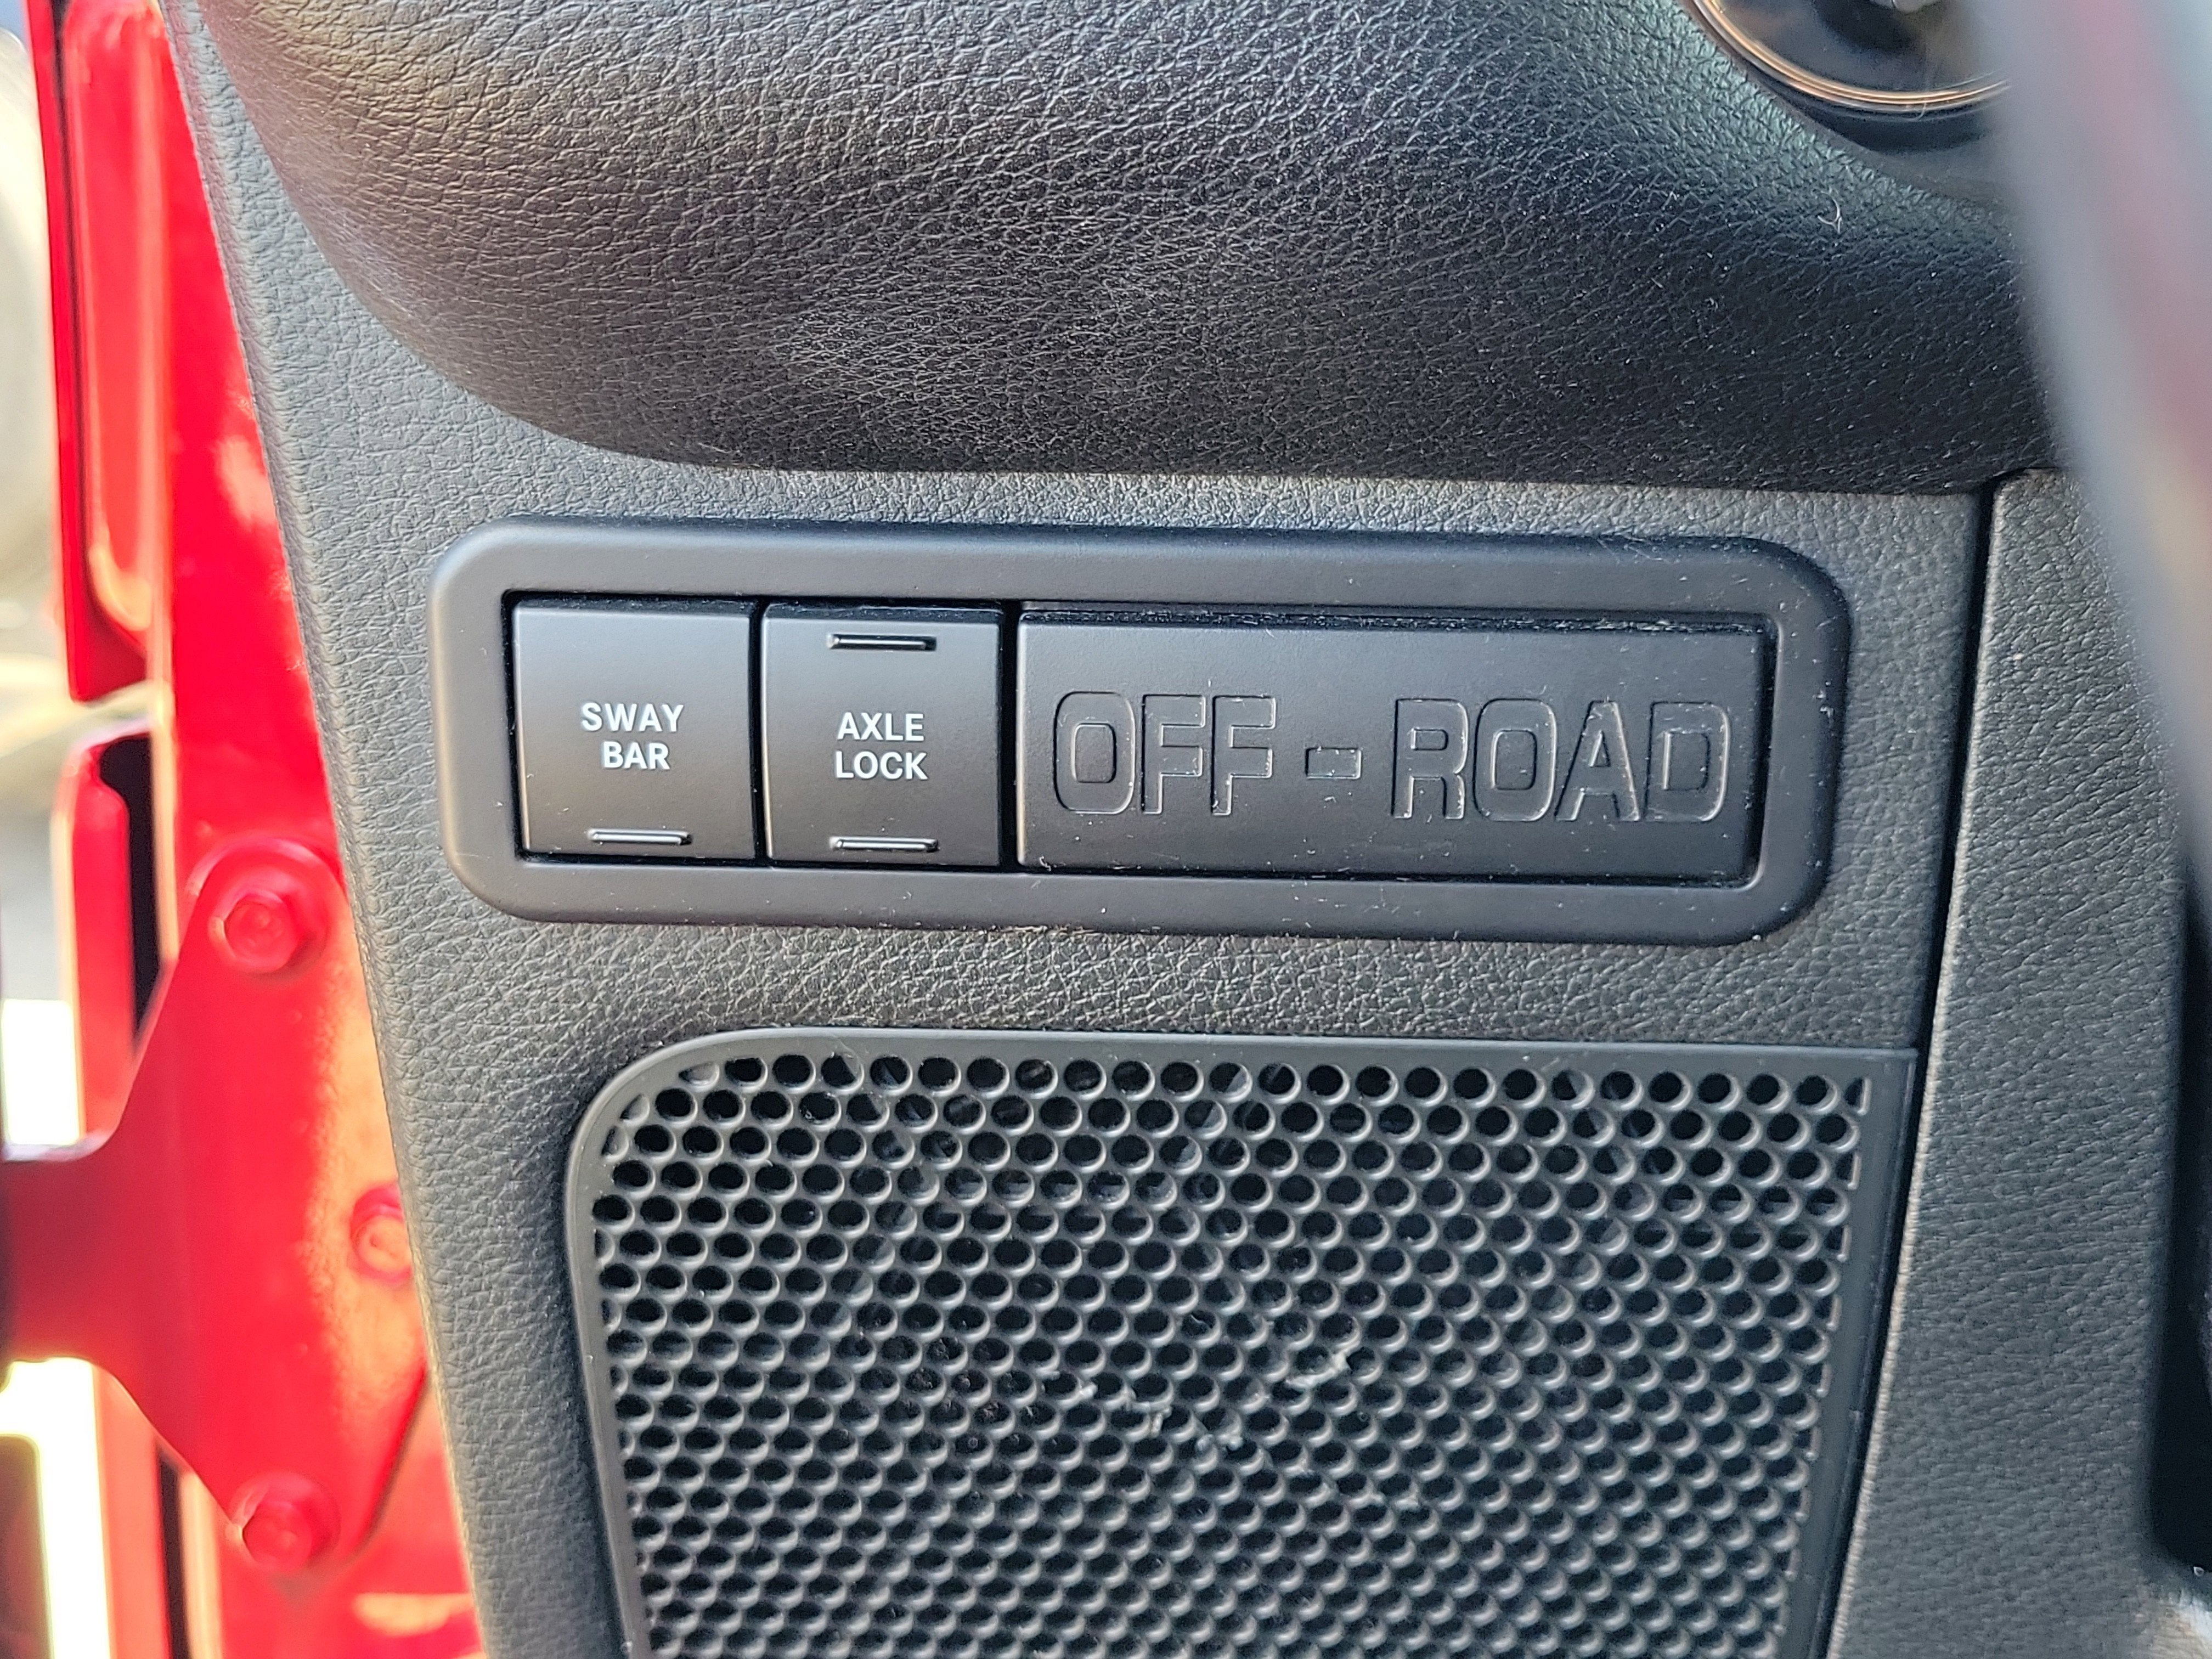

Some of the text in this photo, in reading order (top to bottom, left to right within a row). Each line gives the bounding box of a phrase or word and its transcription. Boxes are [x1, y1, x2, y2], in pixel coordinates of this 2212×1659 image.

[580, 701, 684, 732] SWAY
[837, 712, 925, 742] AXLE
[601, 740, 671, 770] BAR
[834, 750, 929, 780] LOCK
